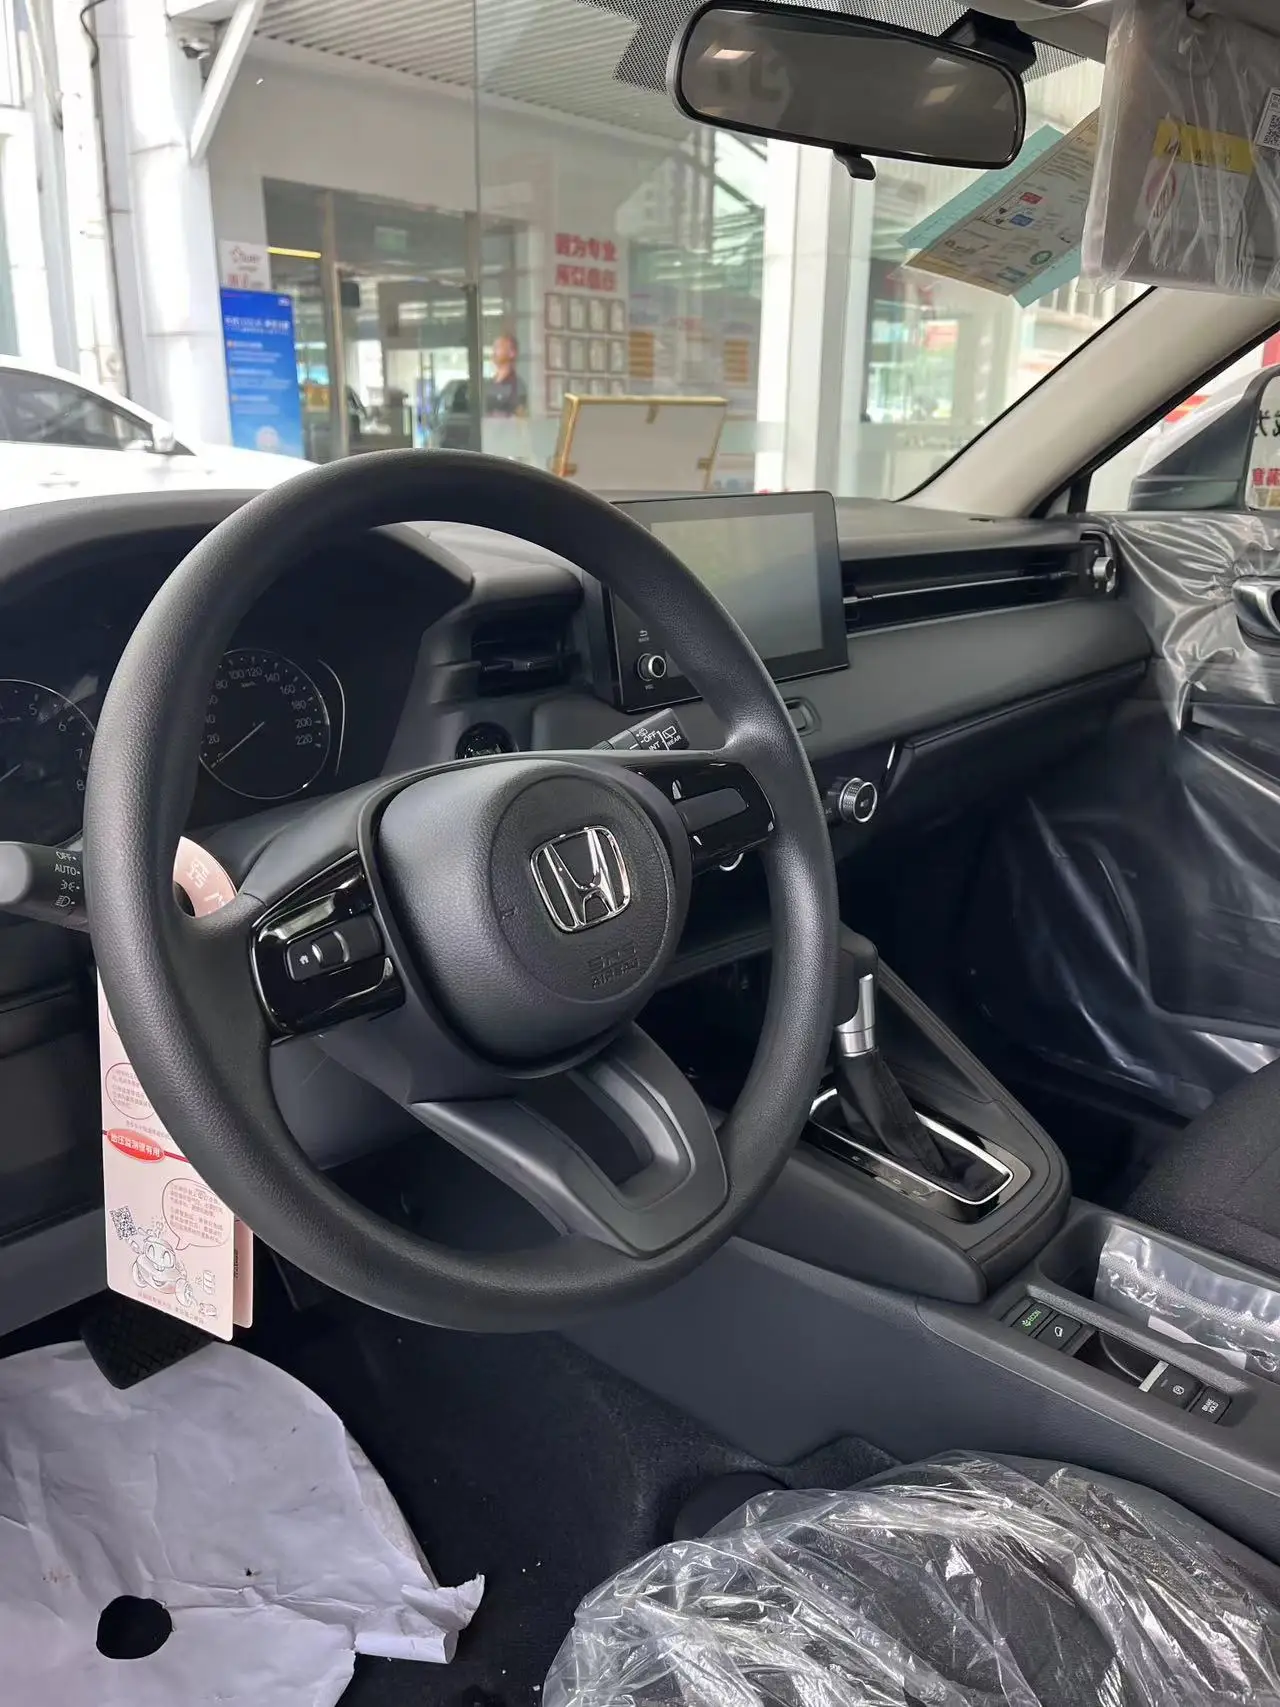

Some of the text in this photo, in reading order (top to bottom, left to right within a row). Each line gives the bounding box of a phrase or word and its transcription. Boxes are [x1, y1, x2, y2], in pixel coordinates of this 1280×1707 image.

[228, 669, 245, 679] 100
[246, 667, 263, 677] 120
[264, 672, 280, 682] 140
[215, 679, 228, 689] 80
[279, 684, 296, 695] 160
[28, 703, 38, 716] 5
[291, 700, 307, 710] 180
[58, 722, 67, 732] 6
[295, 717, 313, 728] 200
[206, 734, 220, 744] 20
[295, 734, 313, 746] 220
[643, 730, 657, 743] OFF
[666, 735, 682, 747] REAR
[648, 741, 661, 751] INT
[75, 748, 84, 760] 7
[76, 779, 85, 791] 8
[55, 851, 72, 862] OFF
[54, 864, 77, 876] AUTO
[1027, 1309, 1042, 1322] ECON
